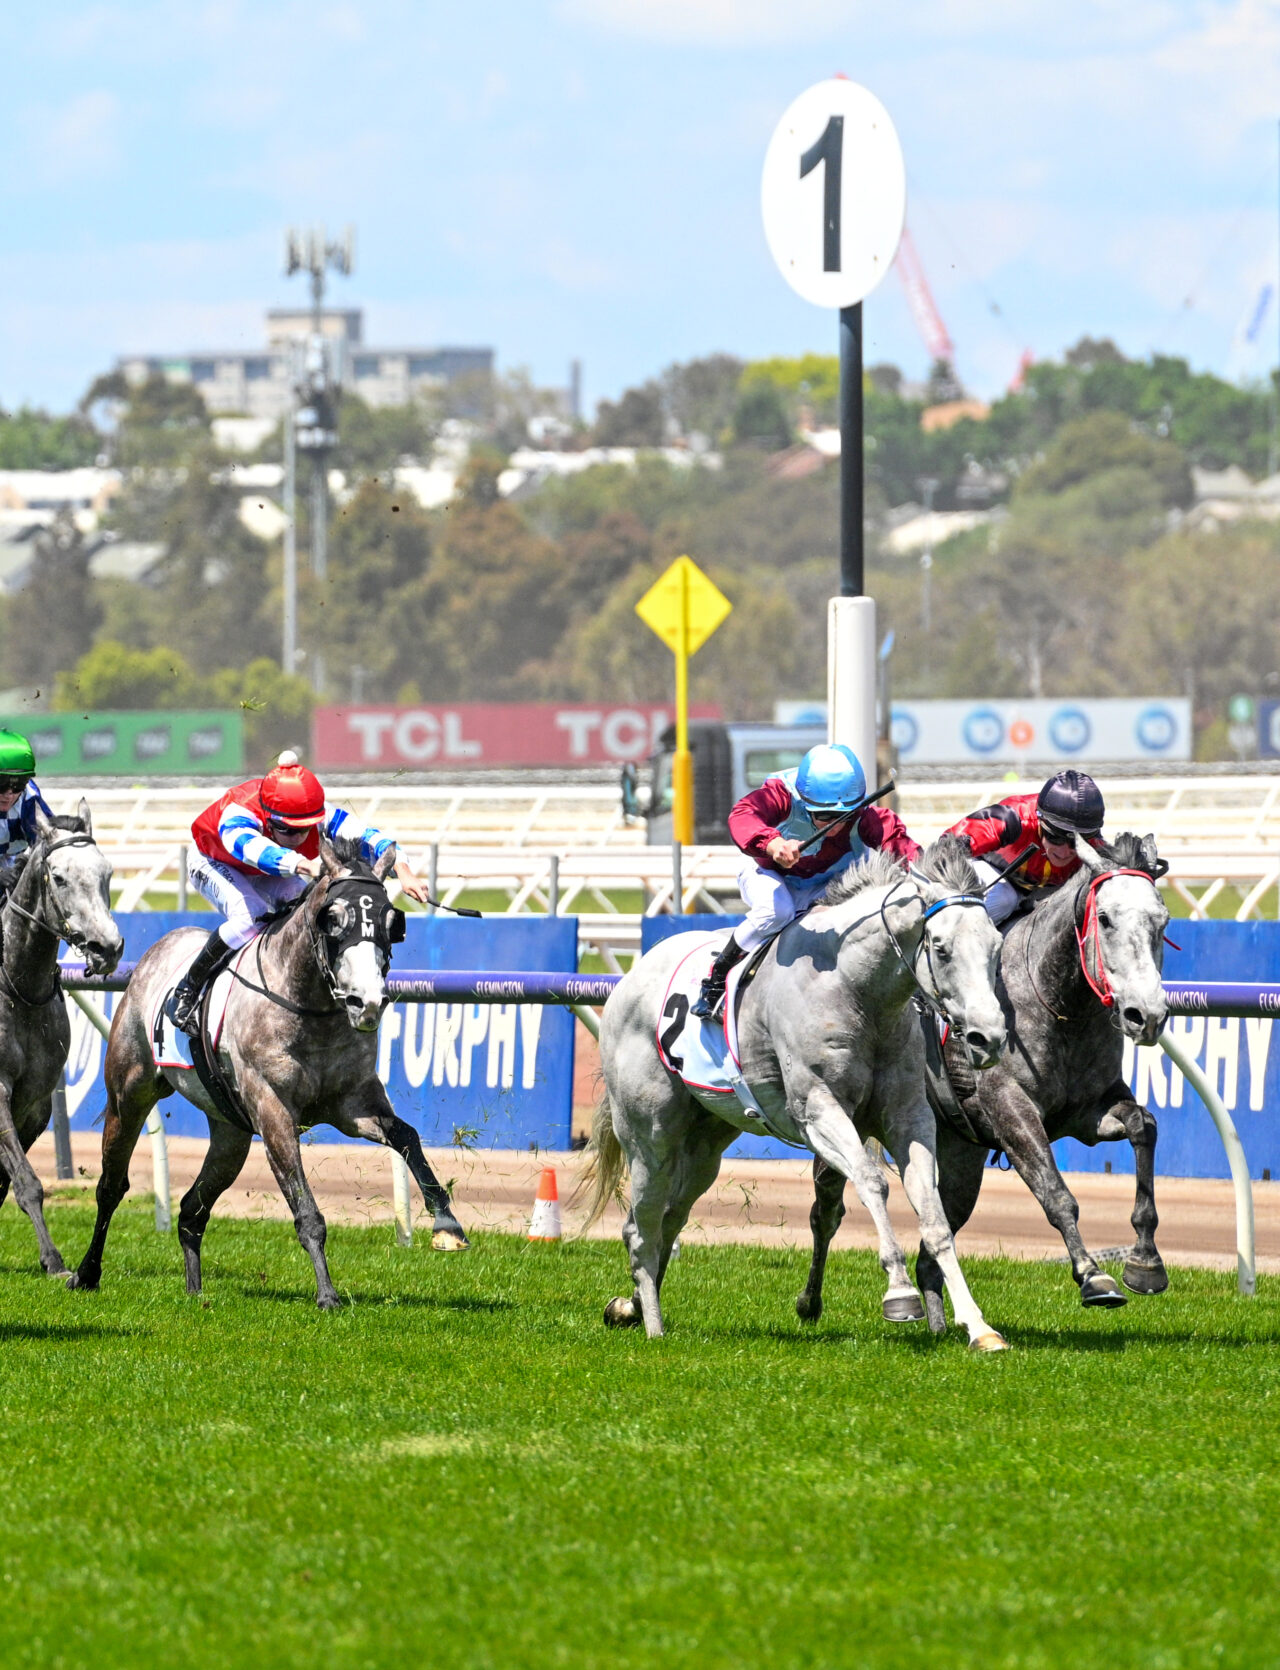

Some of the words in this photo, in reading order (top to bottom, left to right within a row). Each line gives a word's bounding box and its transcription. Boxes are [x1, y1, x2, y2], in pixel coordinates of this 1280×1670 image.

[800, 115, 844, 272] 1
[348, 711, 482, 759] TCL
[359, 895, 375, 937] CLM
[388, 980, 435, 996] FLEMINGTON
[476, 981, 524, 998] FLEMINGTON
[1166, 991, 1208, 1010] MINGTON
[661, 993, 689, 1072] 2
[1121, 1015, 1273, 1111] RPHY
